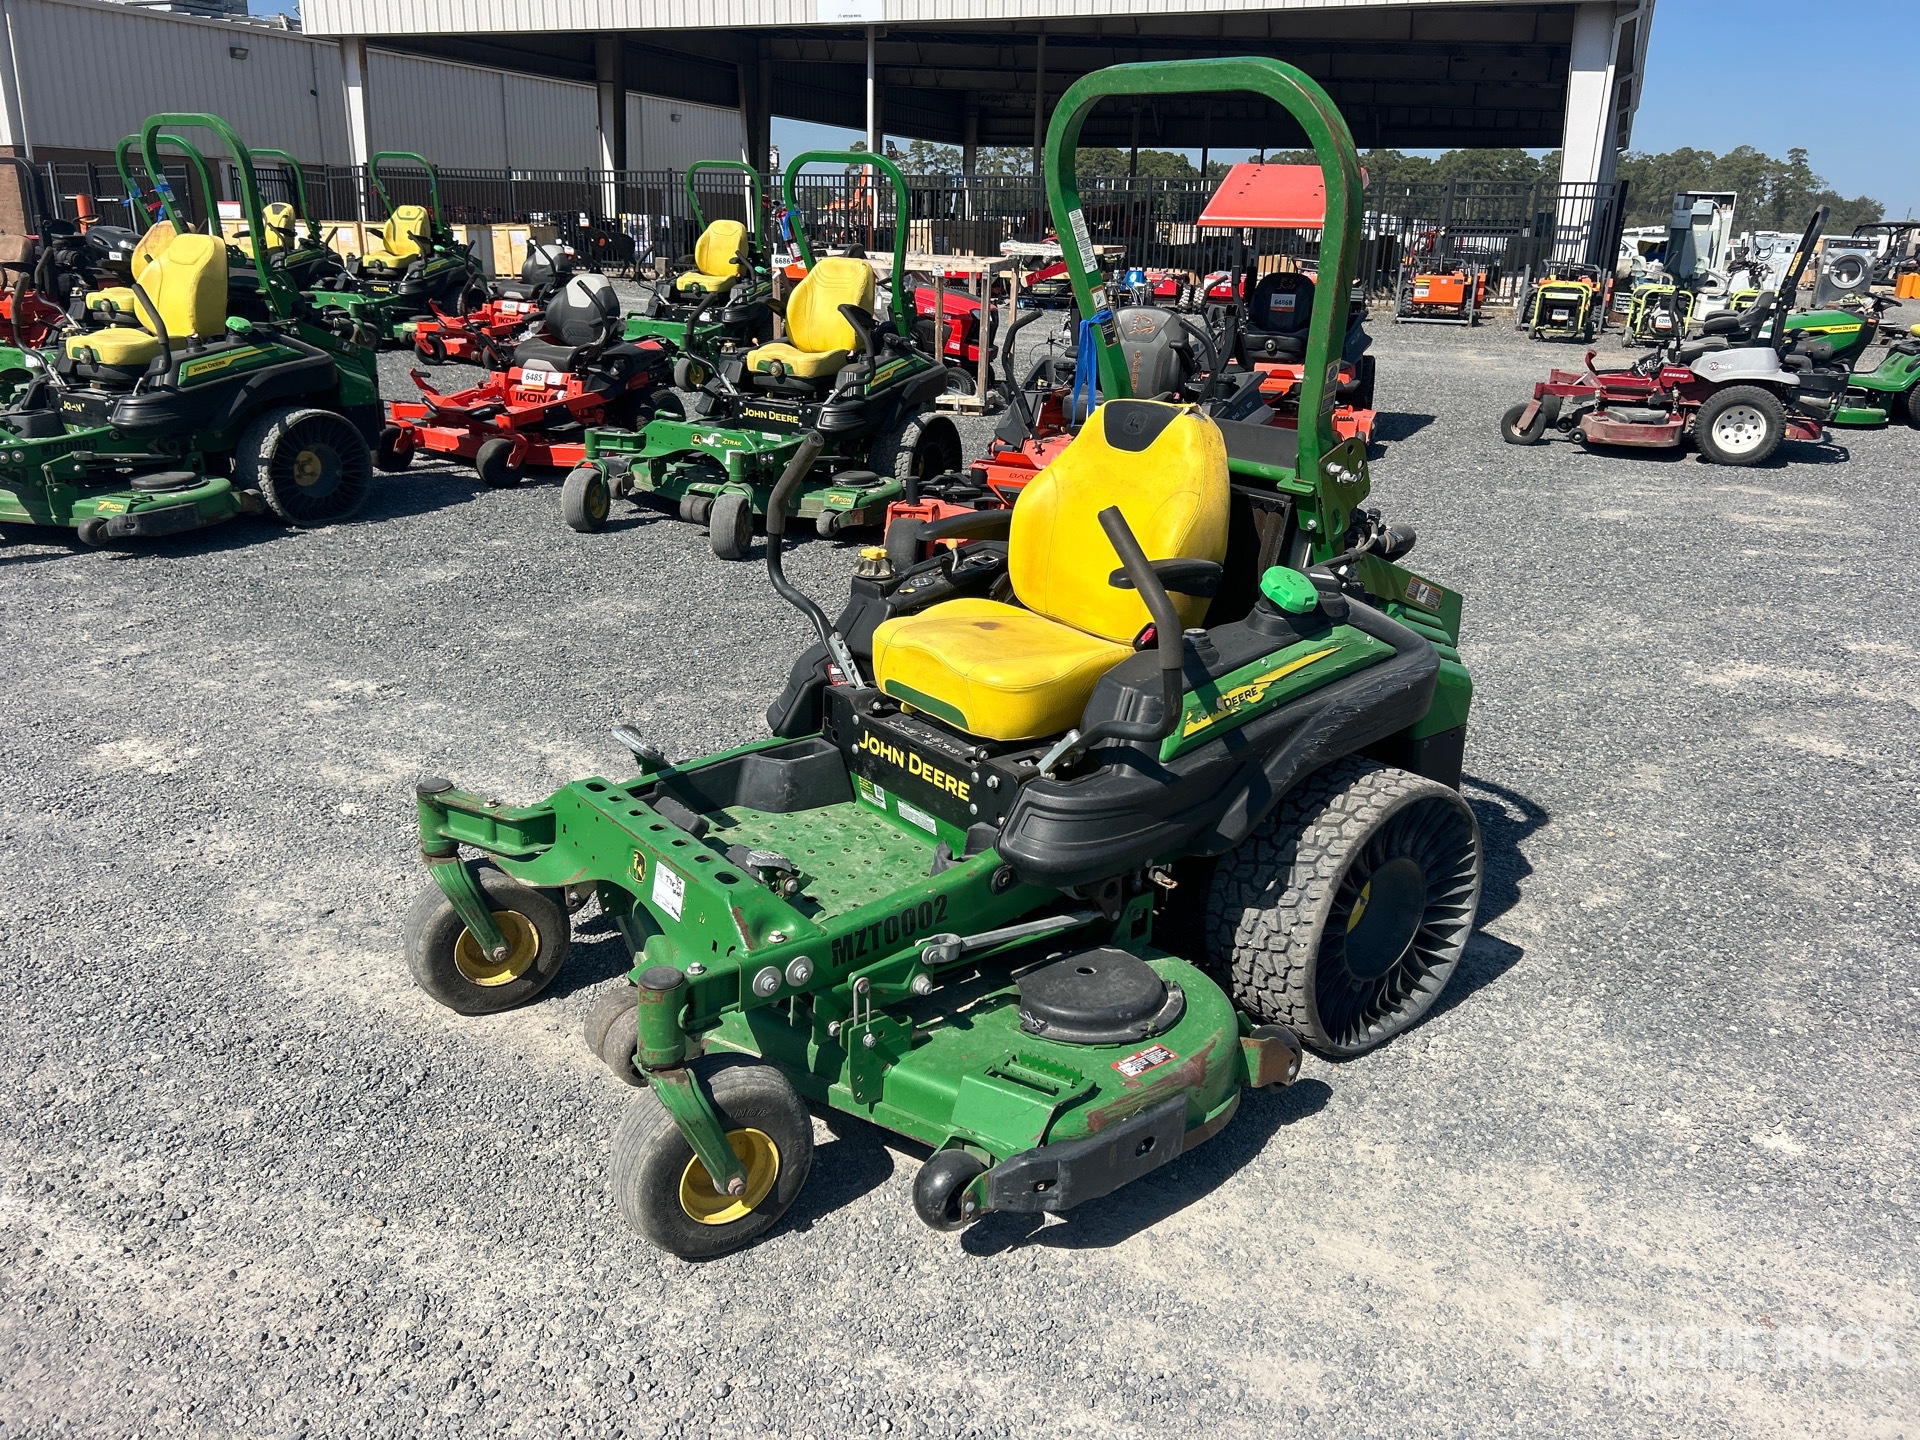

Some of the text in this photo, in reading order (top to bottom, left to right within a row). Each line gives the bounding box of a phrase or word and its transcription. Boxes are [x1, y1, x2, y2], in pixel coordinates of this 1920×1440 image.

[774, 257, 790, 265] 6686
[193, 360, 226, 373] JOHN DEERE
[525, 372, 543, 382] 6485
[515, 391, 548, 404] IKON
[742, 407, 799, 424] JOHN DEERE
[722, 437, 743, 447] ZTRAK
[1223, 686, 1259, 708] DEERE
[859, 729, 904, 768] JOHN
[908, 752, 970, 802] DEERE
[831, 894, 949, 968] MZT0002
